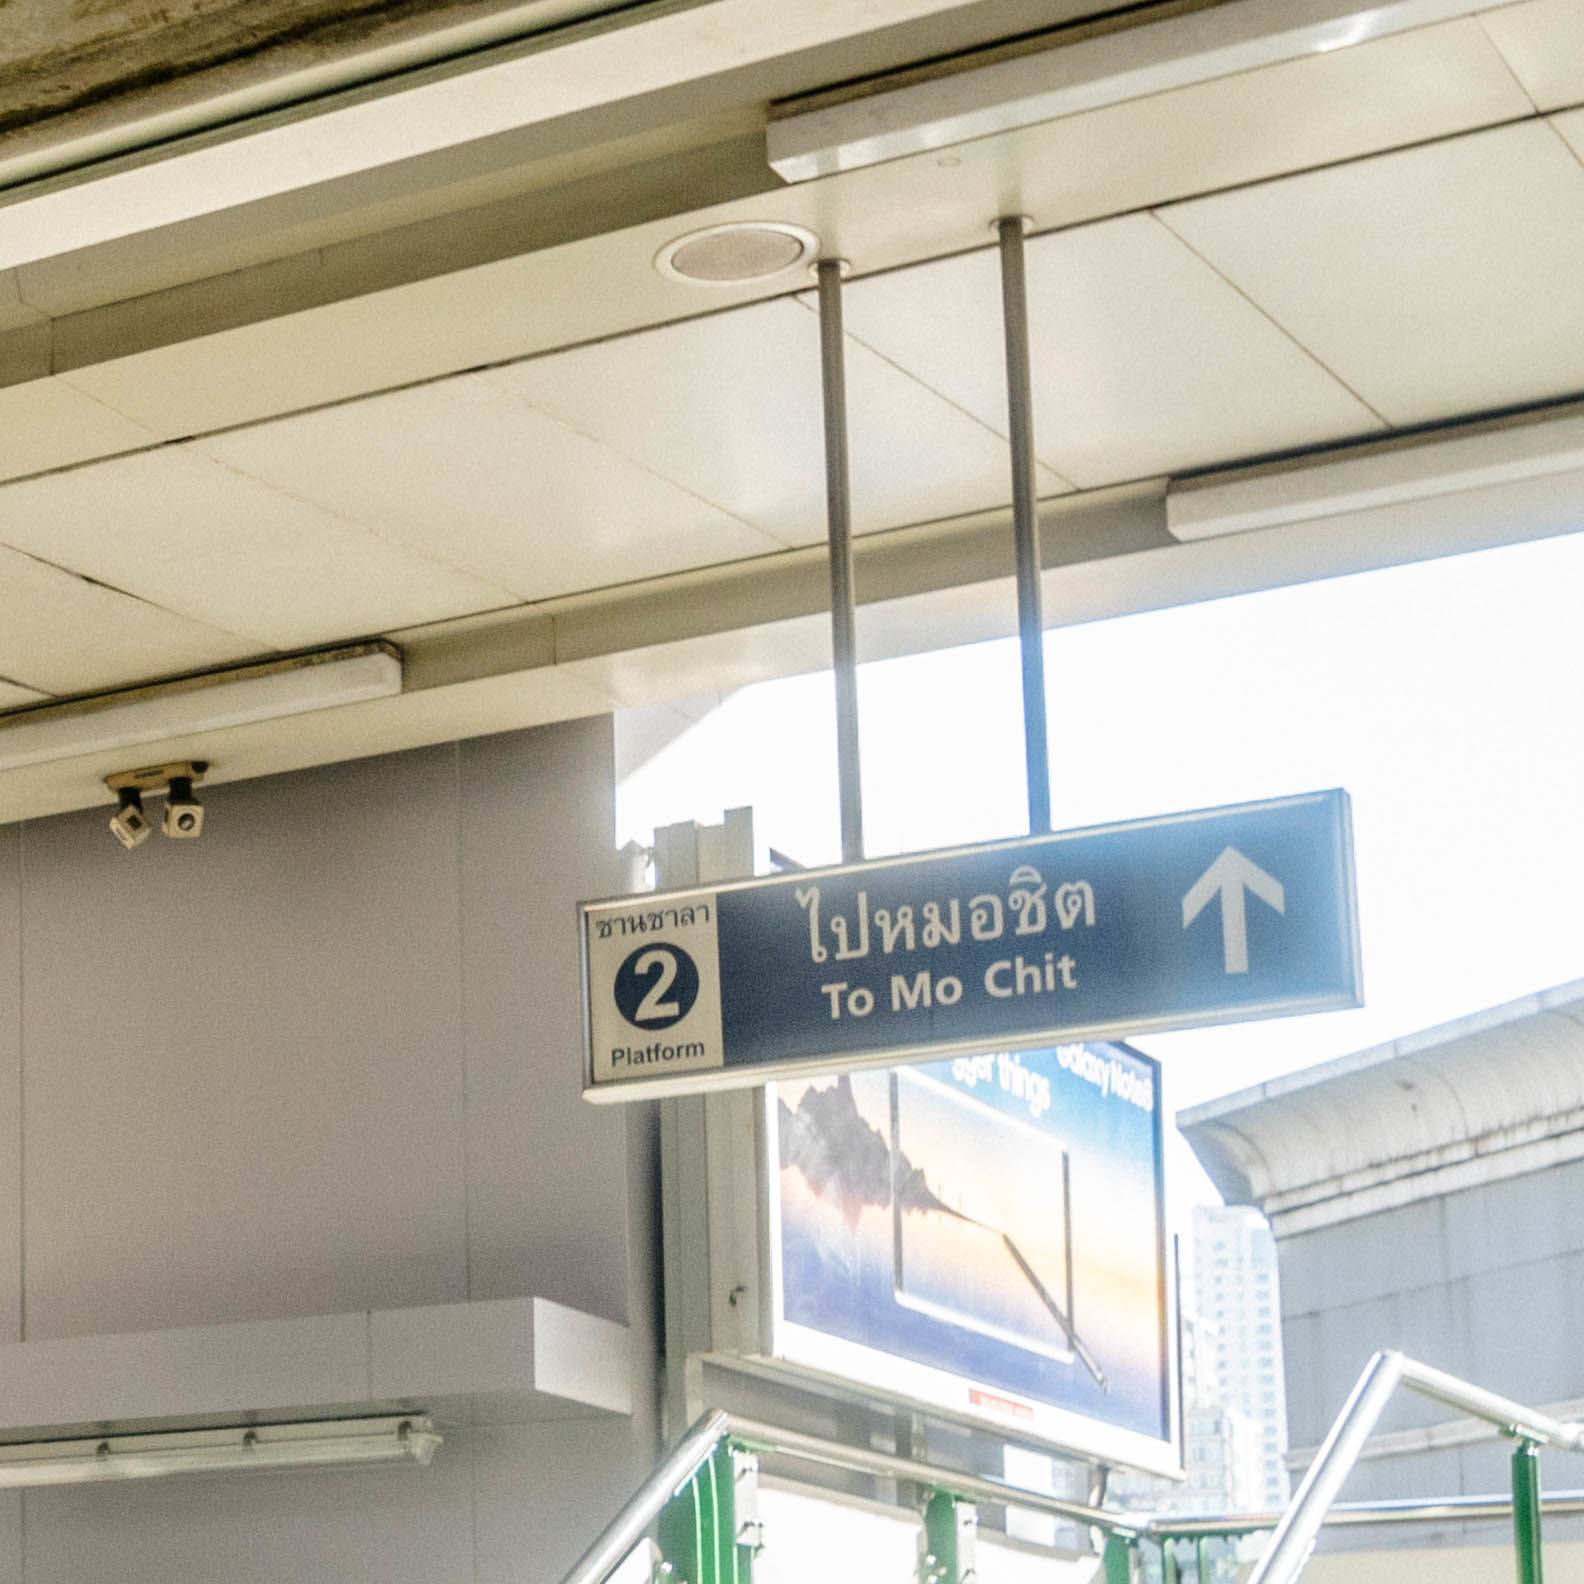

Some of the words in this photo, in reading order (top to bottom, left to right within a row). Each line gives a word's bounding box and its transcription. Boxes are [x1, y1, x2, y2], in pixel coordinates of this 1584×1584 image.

[596, 904, 710, 938] ชานชาลา
[795, 865, 1096, 963] ไปหมอชิต
[634, 949, 680, 1022] 2
[821, 982, 874, 1020] To
[890, 971, 963, 1011] Mo
[984, 952, 1077, 998] Chit
[611, 1042, 705, 1067] Platform
